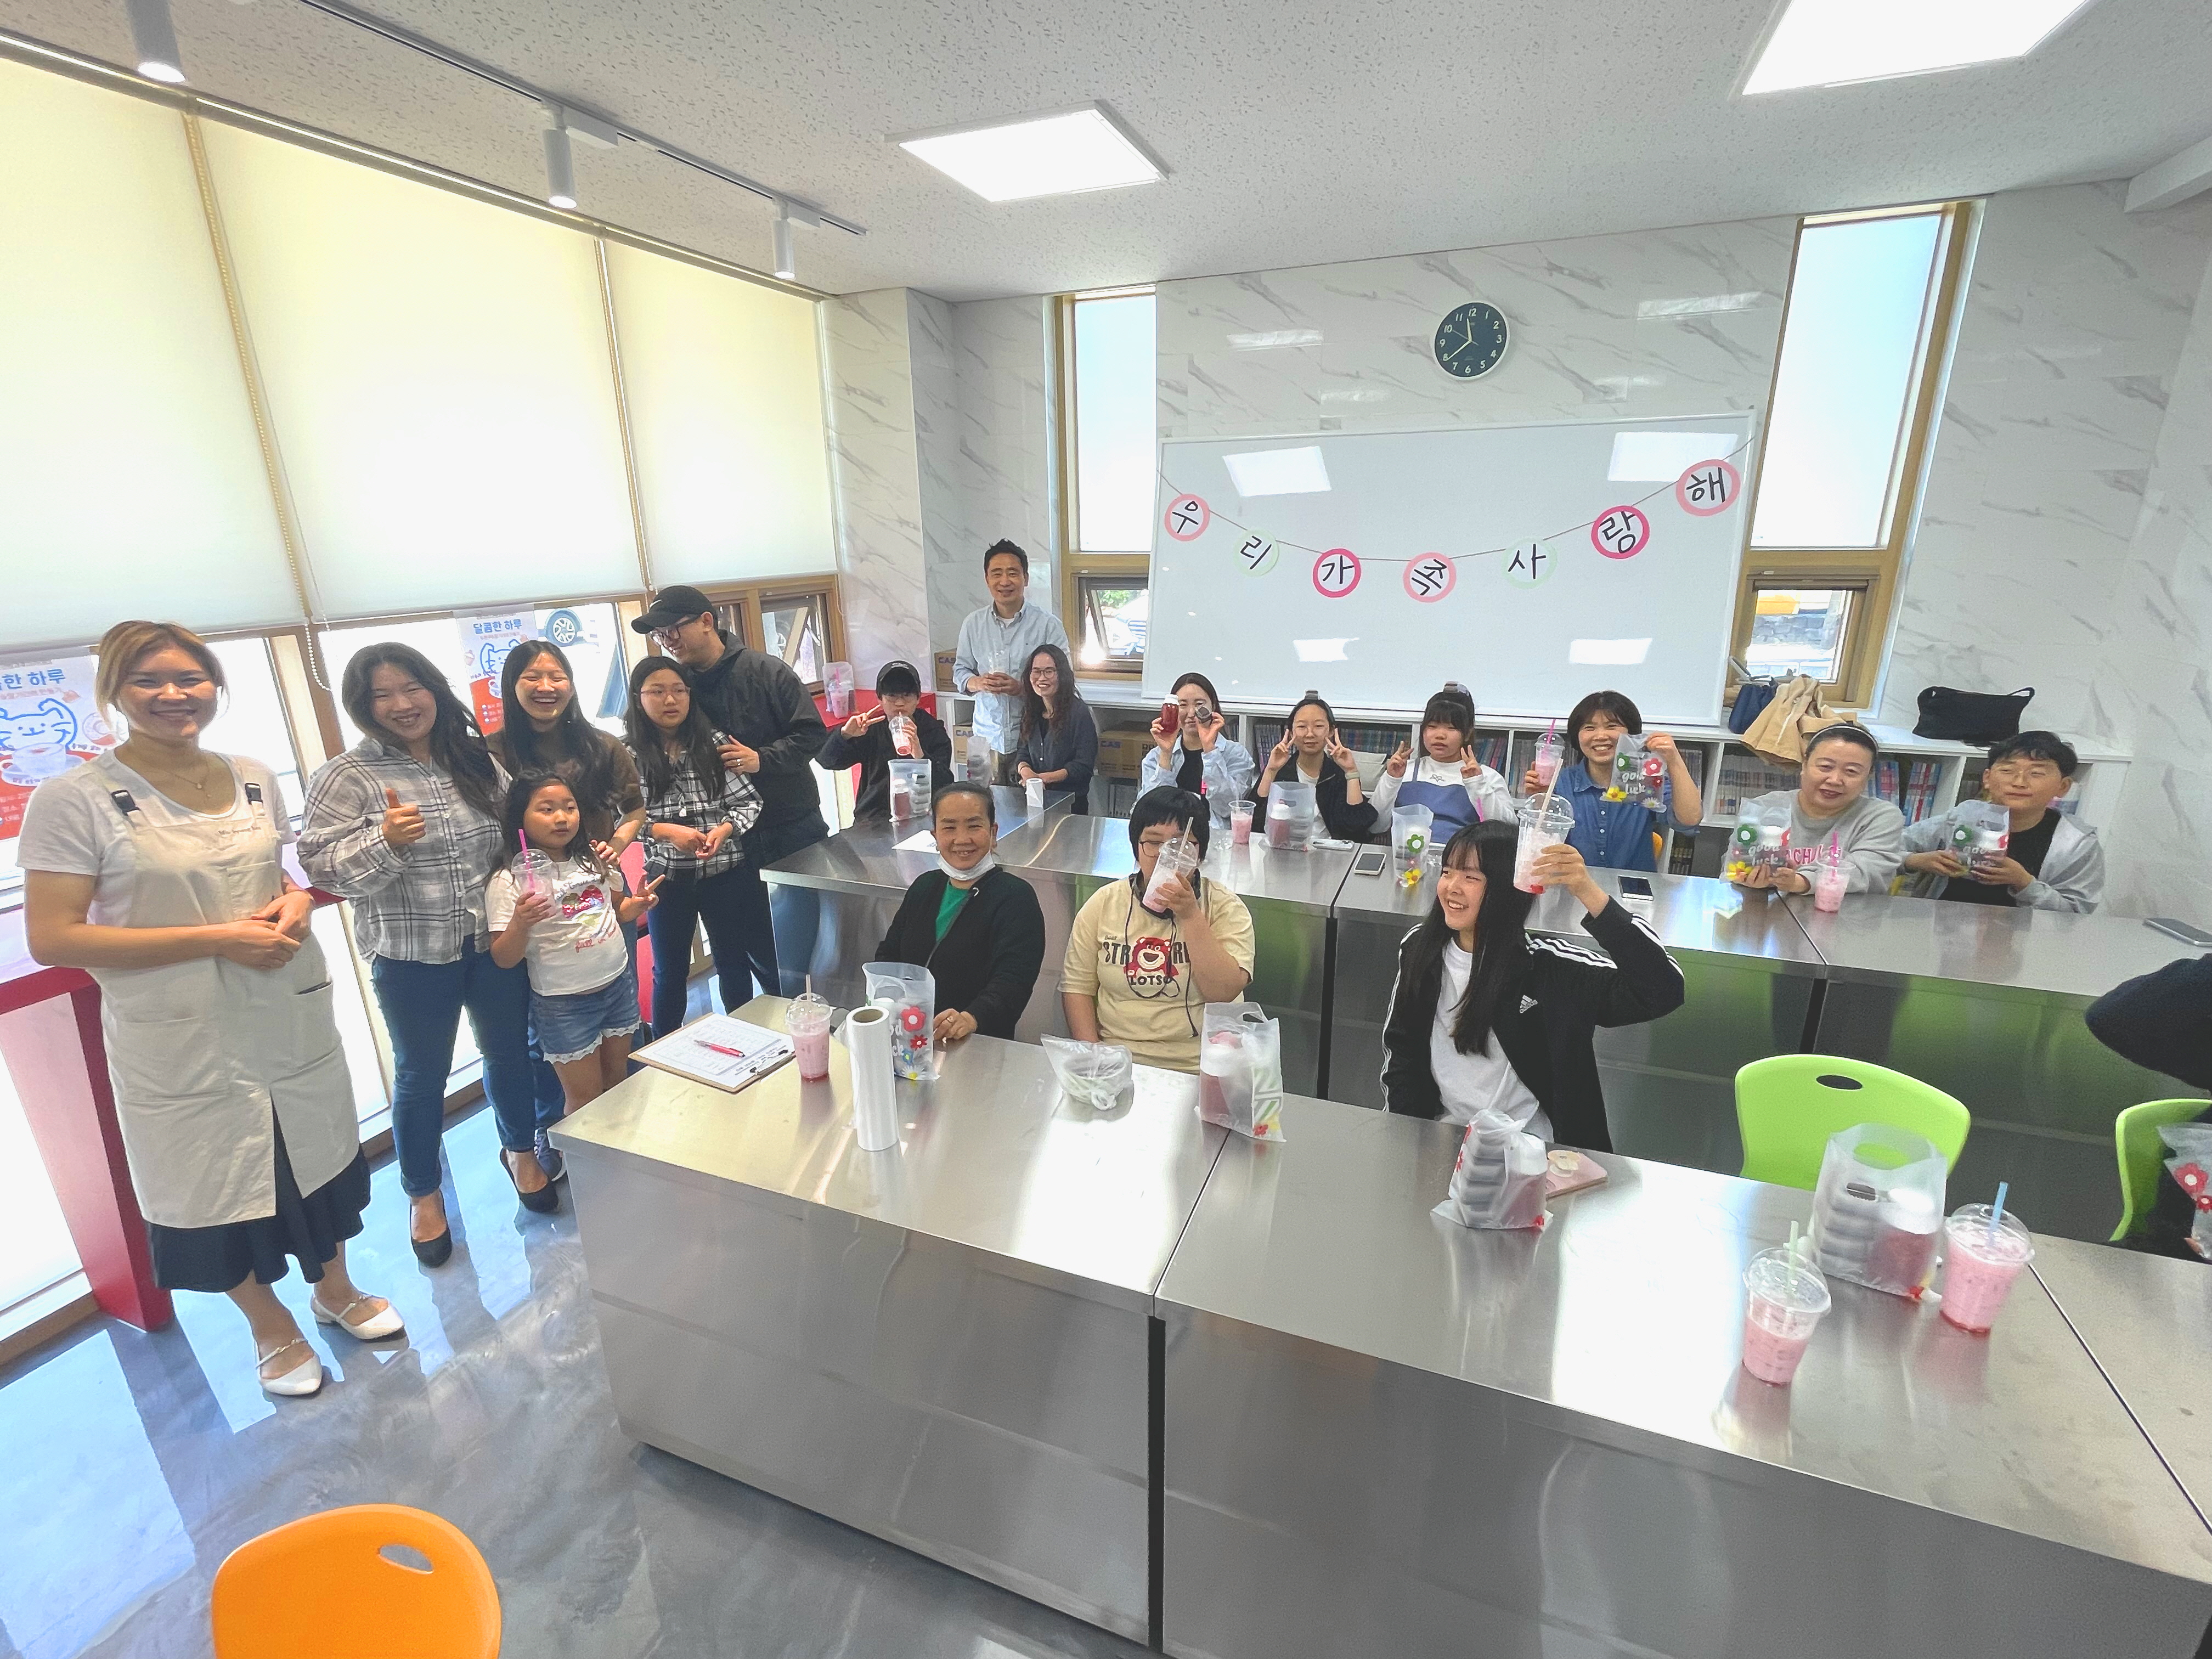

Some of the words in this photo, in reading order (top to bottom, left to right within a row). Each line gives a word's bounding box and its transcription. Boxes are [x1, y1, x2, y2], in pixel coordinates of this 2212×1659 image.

[1455, 313, 1463, 321] 11
[1468, 308, 1477, 317] 12
[1485, 311, 1489, 319] 1
[1443, 324, 1453, 334] 10
[1493, 320, 1499, 330] 2
[1440, 338, 1446, 348] 9
[1496, 334, 1502, 344] 3
[1442, 353, 1449, 362] 8
[1490, 349, 1497, 358] 4
[1452, 362, 1458, 370] 7
[1480, 359, 1486, 369] 5
[1465, 365, 1471, 374] 6
[473, 621, 502, 635] 달콤한
[504, 618, 522, 630] 하루
[0, 673, 22, 690] 한
[27, 668, 66, 686] 하루
[1101, 740, 1121, 749] CAS
